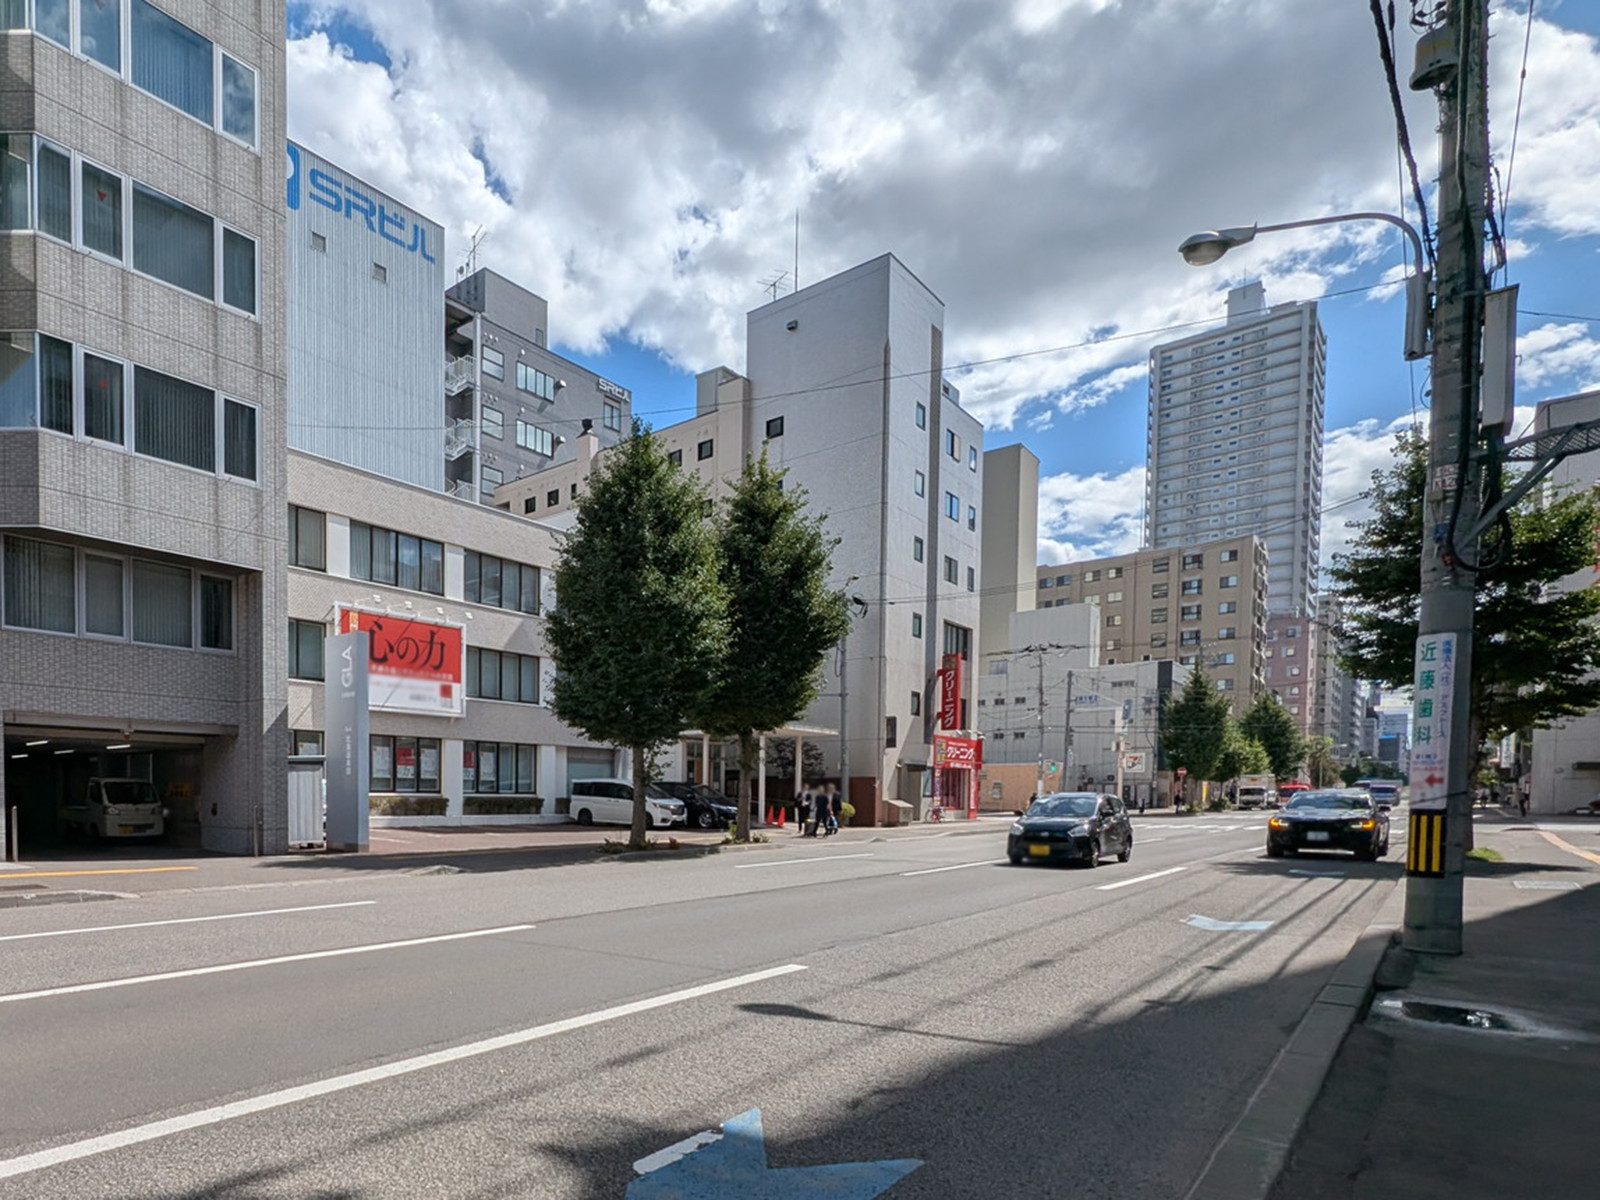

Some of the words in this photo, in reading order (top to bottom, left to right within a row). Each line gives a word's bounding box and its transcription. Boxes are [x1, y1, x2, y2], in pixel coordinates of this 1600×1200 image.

[309, 168, 436, 265] SRビル
[341, 645, 353, 688] GLA
[369, 620, 446, 671] 心の力
[1416, 641, 1437, 745] 近藤歯科
